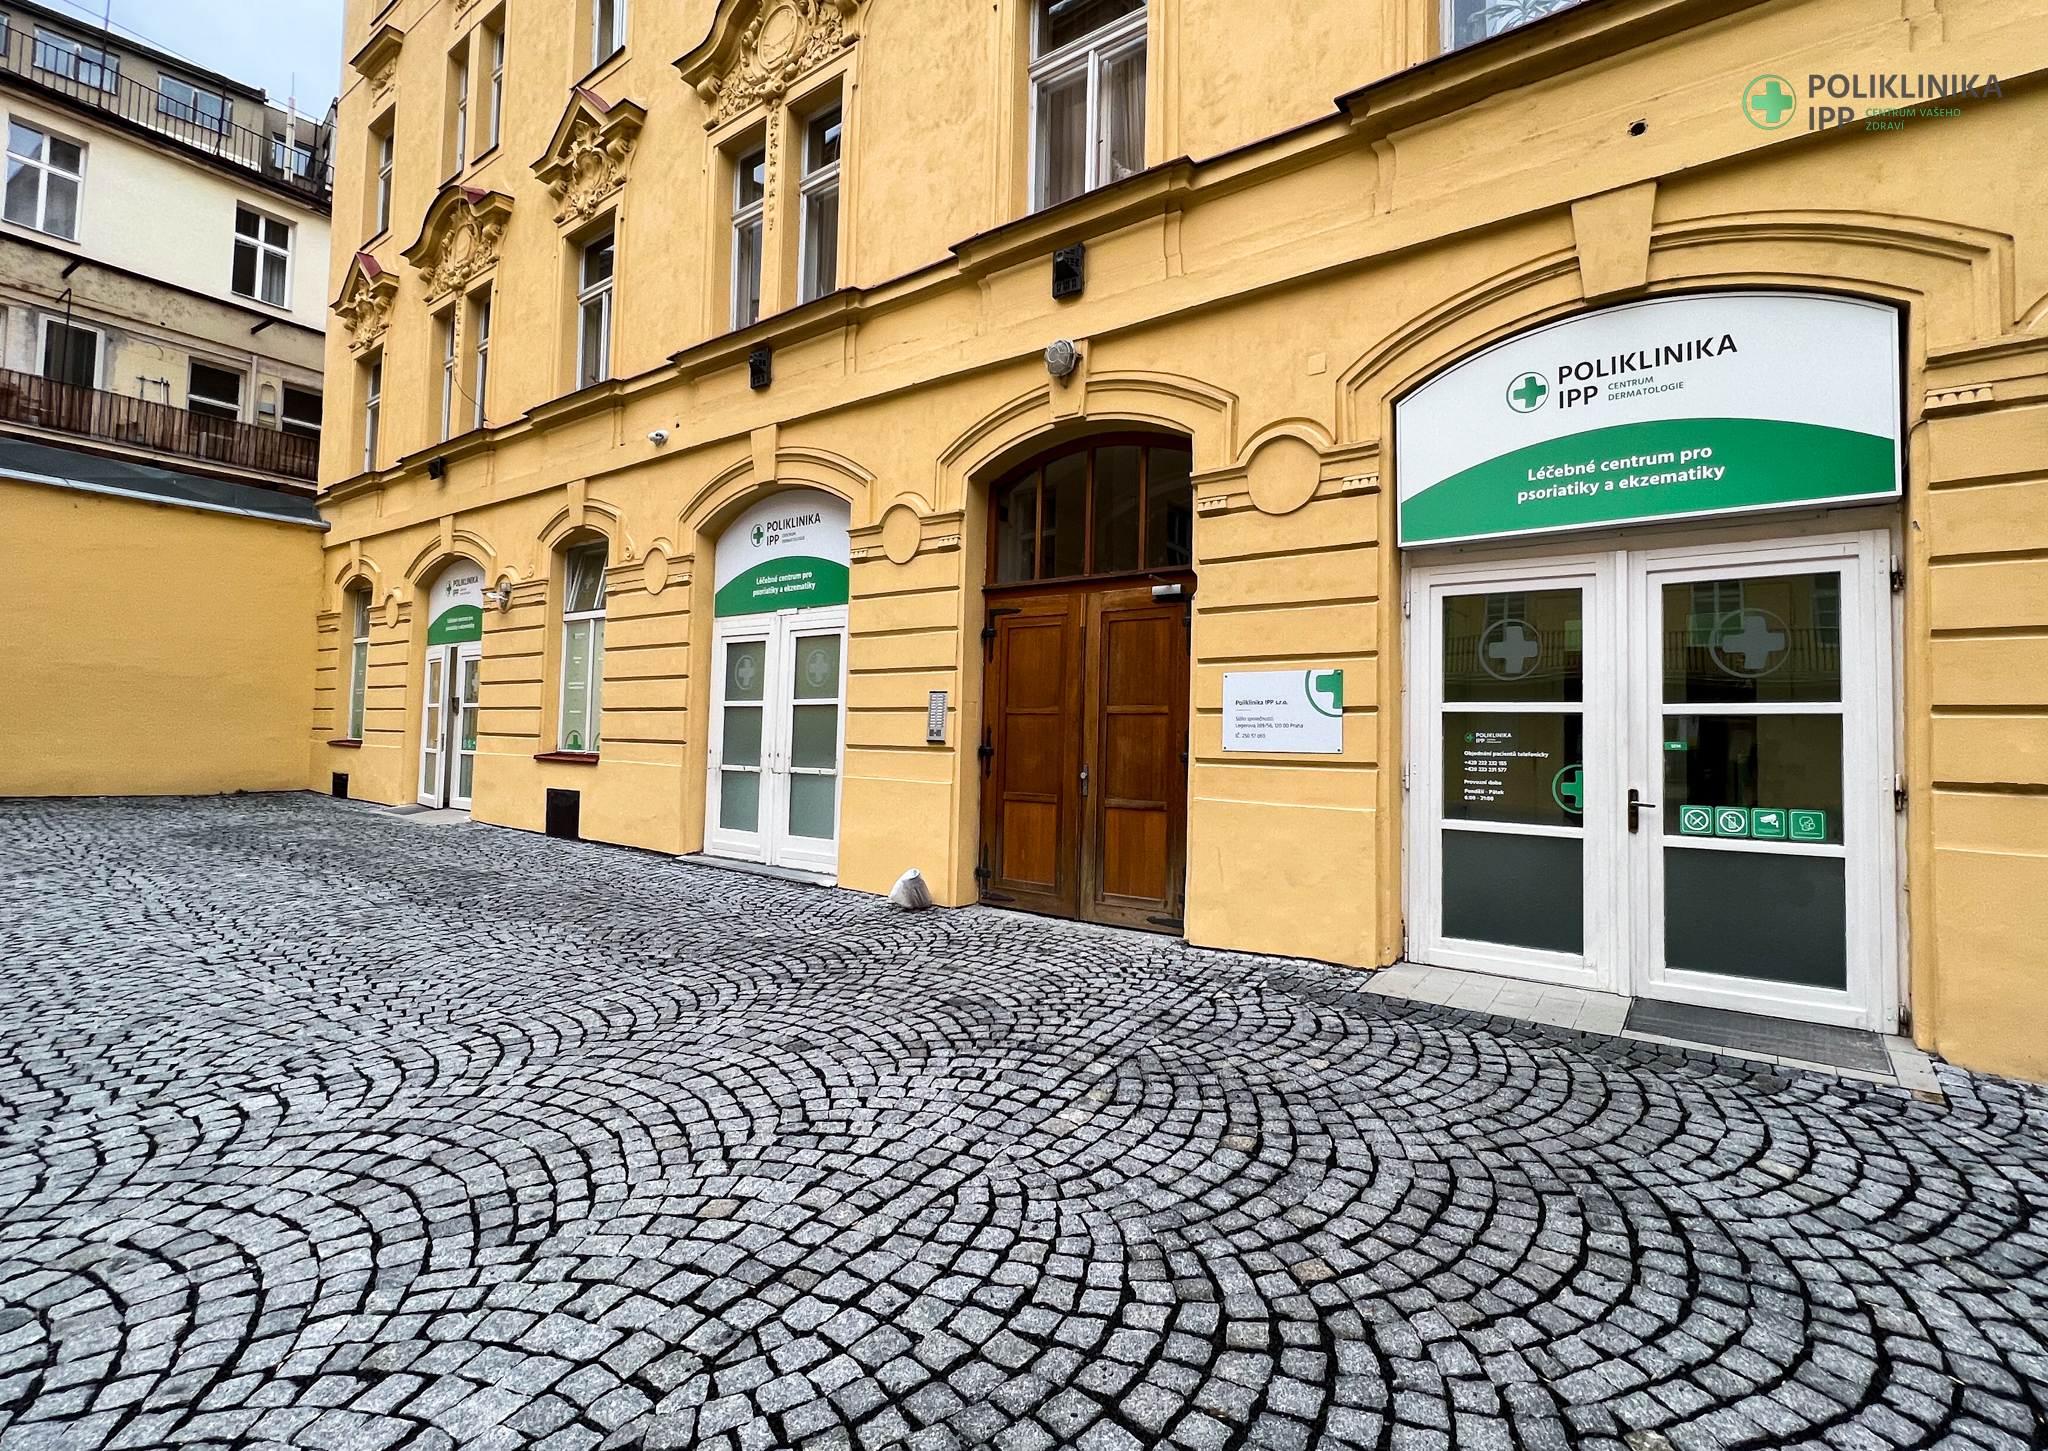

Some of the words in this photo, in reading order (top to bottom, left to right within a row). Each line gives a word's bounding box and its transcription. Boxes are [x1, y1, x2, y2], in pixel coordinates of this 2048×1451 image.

[1558, 333, 1738, 385] POLIKLINIKA
[1607, 376, 1654, 390] CENTRUM
[1607, 381, 1684, 401] DERMATOLOGIE
[1559, 385, 1599, 409] IPP
[1527, 460, 1596, 481] Léčebné
[1600, 451, 1674, 471] centrum
[1680, 447, 1712, 465] pro
[1517, 481, 1599, 504] psoriatiky
[1604, 481, 1614, 491] a
[1618, 465, 1725, 489] ekzematiky
[767, 512, 821, 532] POLIKLINIKA
[767, 534, 780, 546] IPP
[756, 575, 778, 585] Léčebné
[778, 573, 801, 582] centrum
[802, 571, 813, 580] pro
